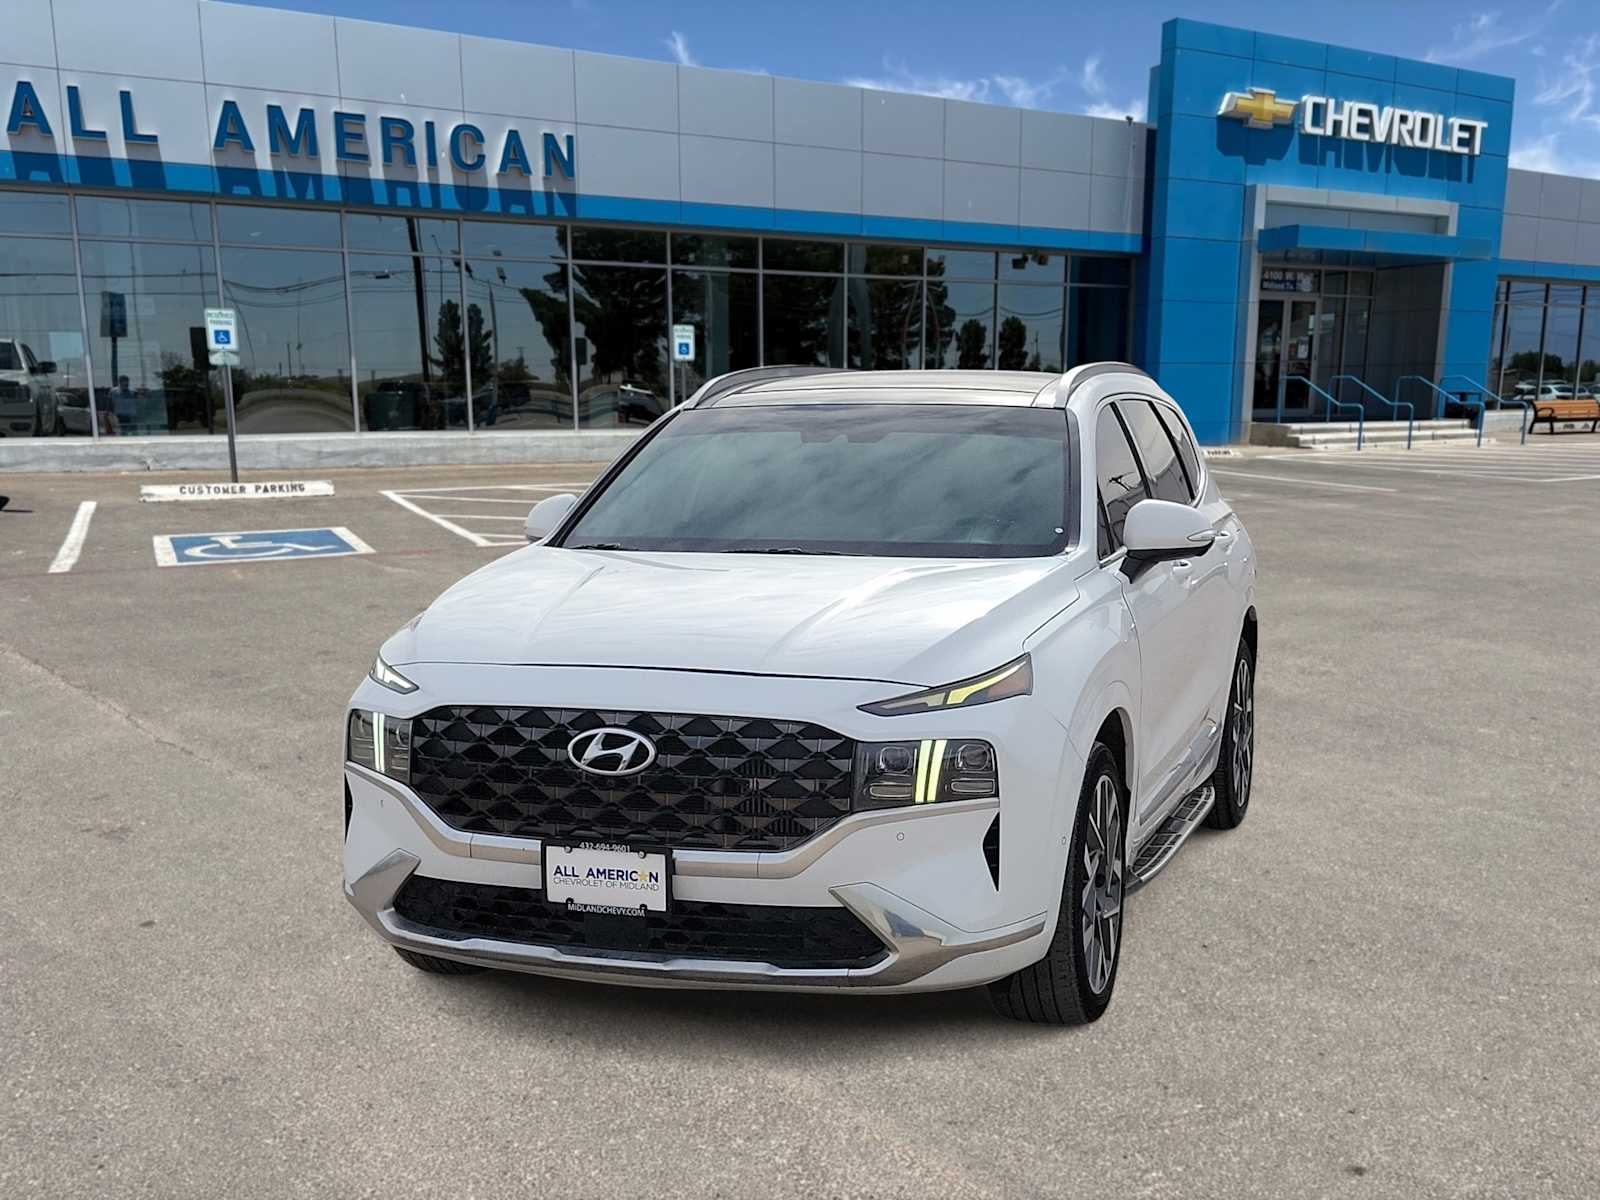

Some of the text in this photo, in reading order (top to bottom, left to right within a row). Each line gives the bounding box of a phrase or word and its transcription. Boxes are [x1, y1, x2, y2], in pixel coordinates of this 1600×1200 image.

[6, 80, 576, 180] ALL AMERICAN
[1301, 94, 1488, 156] CHEVROLET
[179, 483, 306, 495] CUSTOMER PARKING
[553, 865, 579, 878] ALL
[553, 876, 659, 891] CHEVROLET OF MIDLAND
[567, 902, 646, 917] MIDLANDCHEVY.COM
